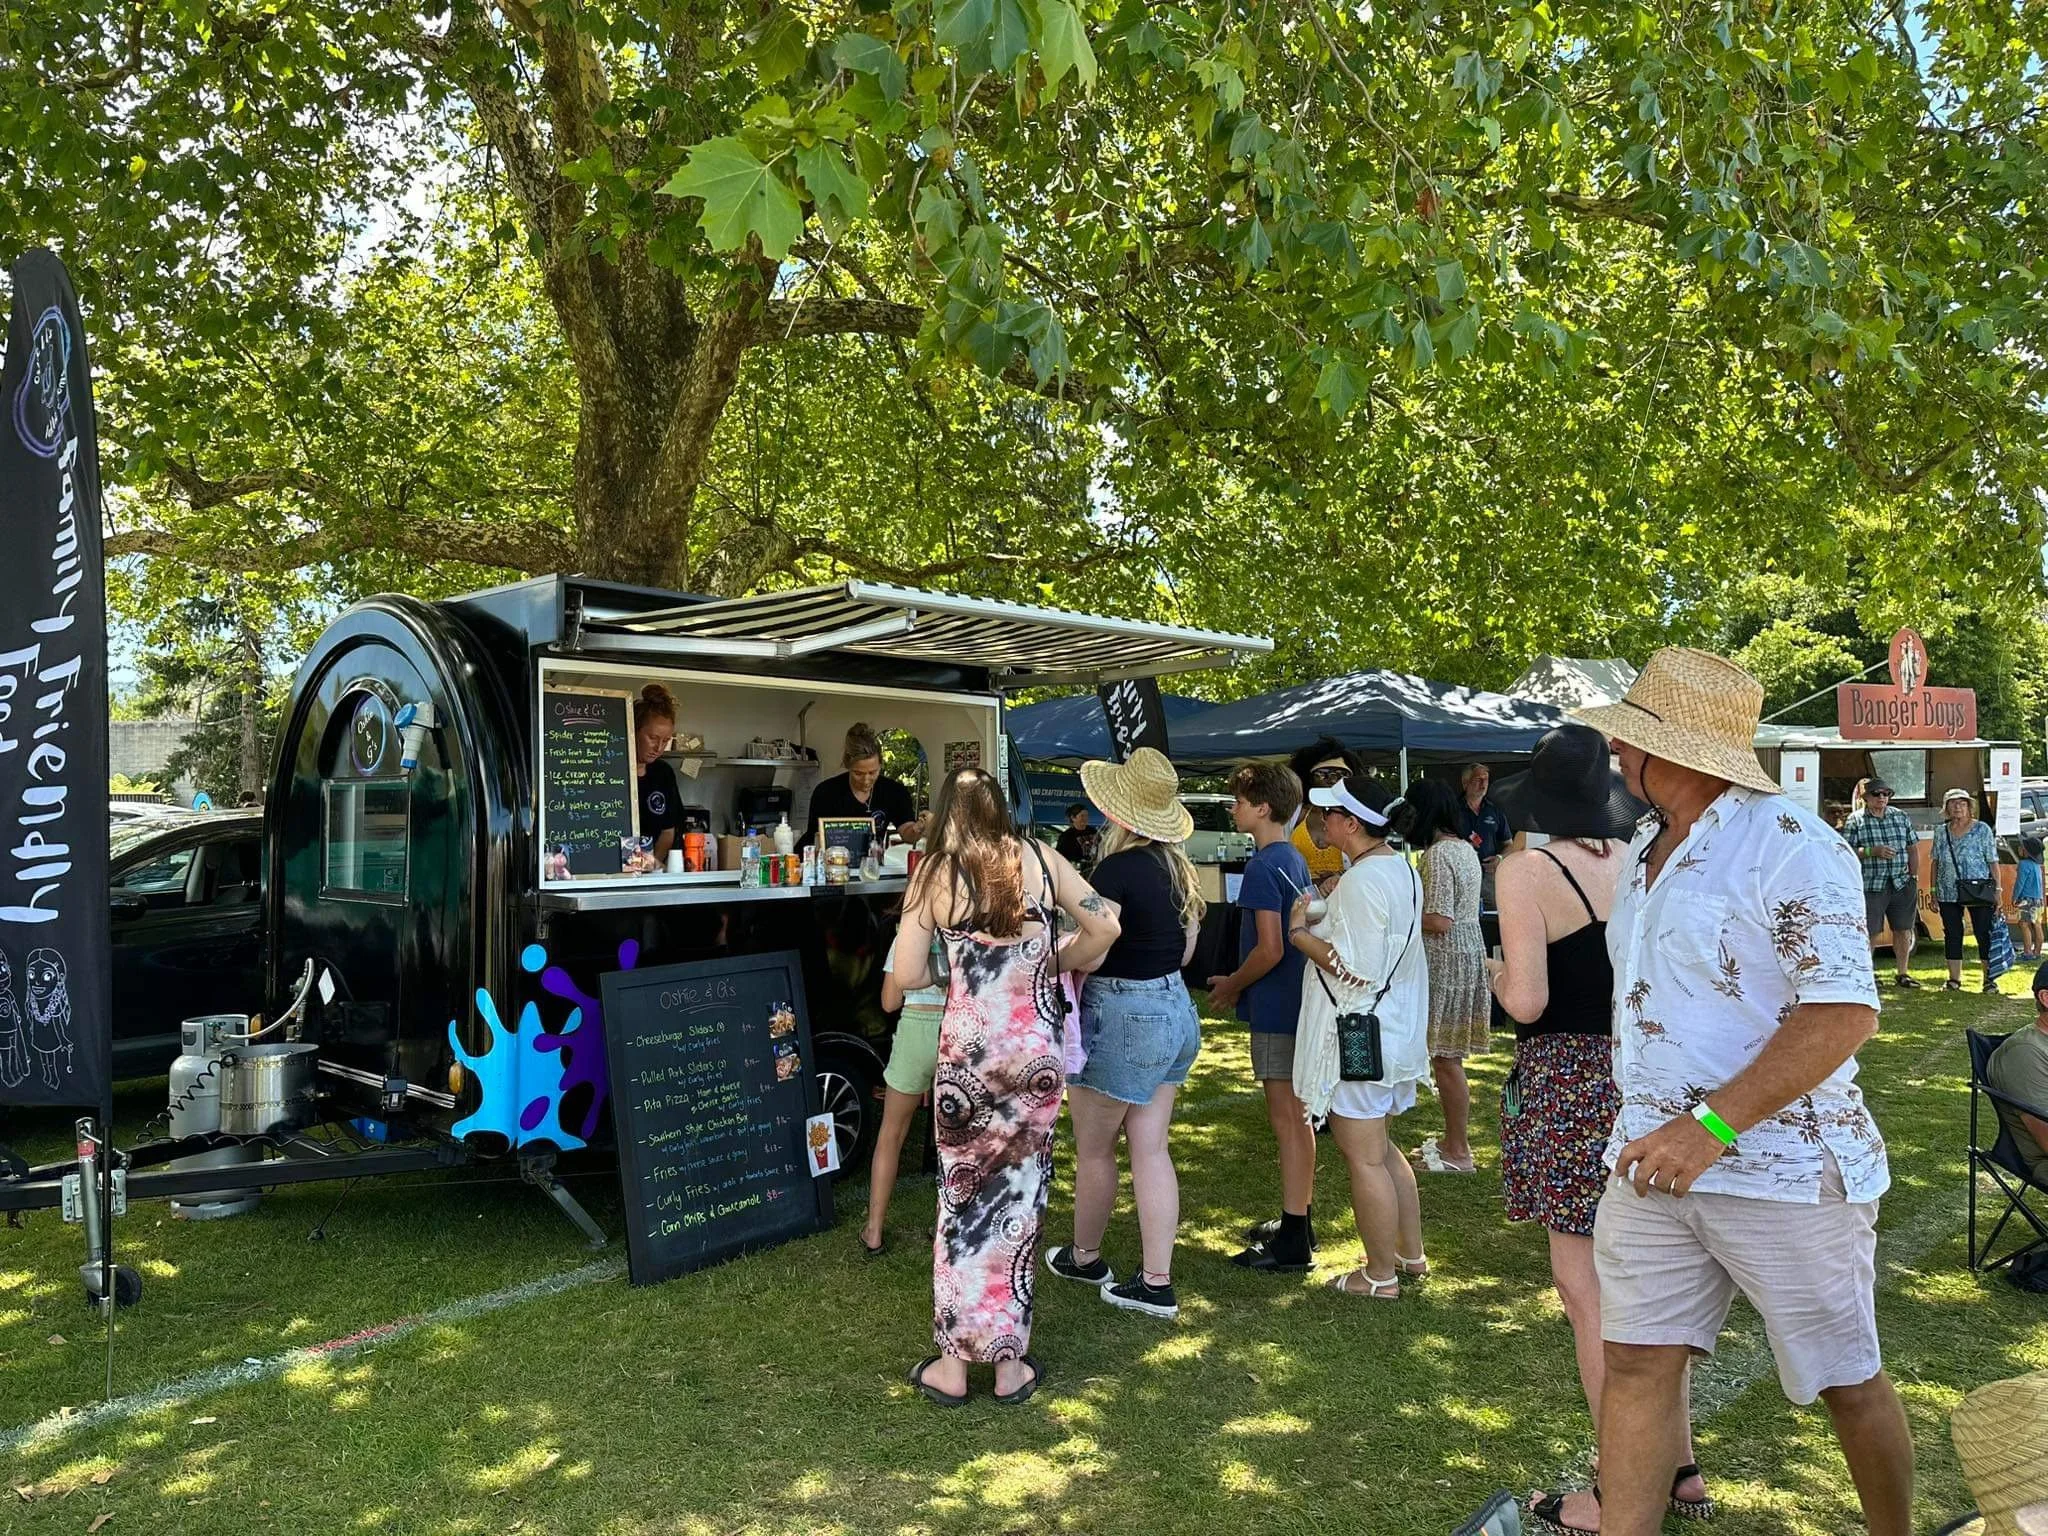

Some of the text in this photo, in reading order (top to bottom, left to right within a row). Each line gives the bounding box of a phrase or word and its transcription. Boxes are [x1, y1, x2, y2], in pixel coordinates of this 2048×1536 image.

[31, 436, 83, 632] Family
[555, 702, 582, 716] Oshie
[1850, 688, 1967, 738] Banger Boys
[356, 705, 375, 734] Oshie
[365, 730, 372, 742] &
[0, 654, 82, 922] Friendly
[660, 987, 701, 1010] Oshie
[636, 1030, 682, 1048] Cheeseburger
[641, 1069, 664, 1086] Pulled
[668, 1066, 685, 1078] Pork
[688, 1060, 714, 1074] Sliders
[644, 1098, 661, 1112] Pita
[649, 1129, 682, 1147] Southern
[653, 1166, 678, 1183] Fries
[657, 1189, 682, 1211] Curly
[685, 1183, 710, 1200] Fries
[661, 1219, 680, 1236] Corn
